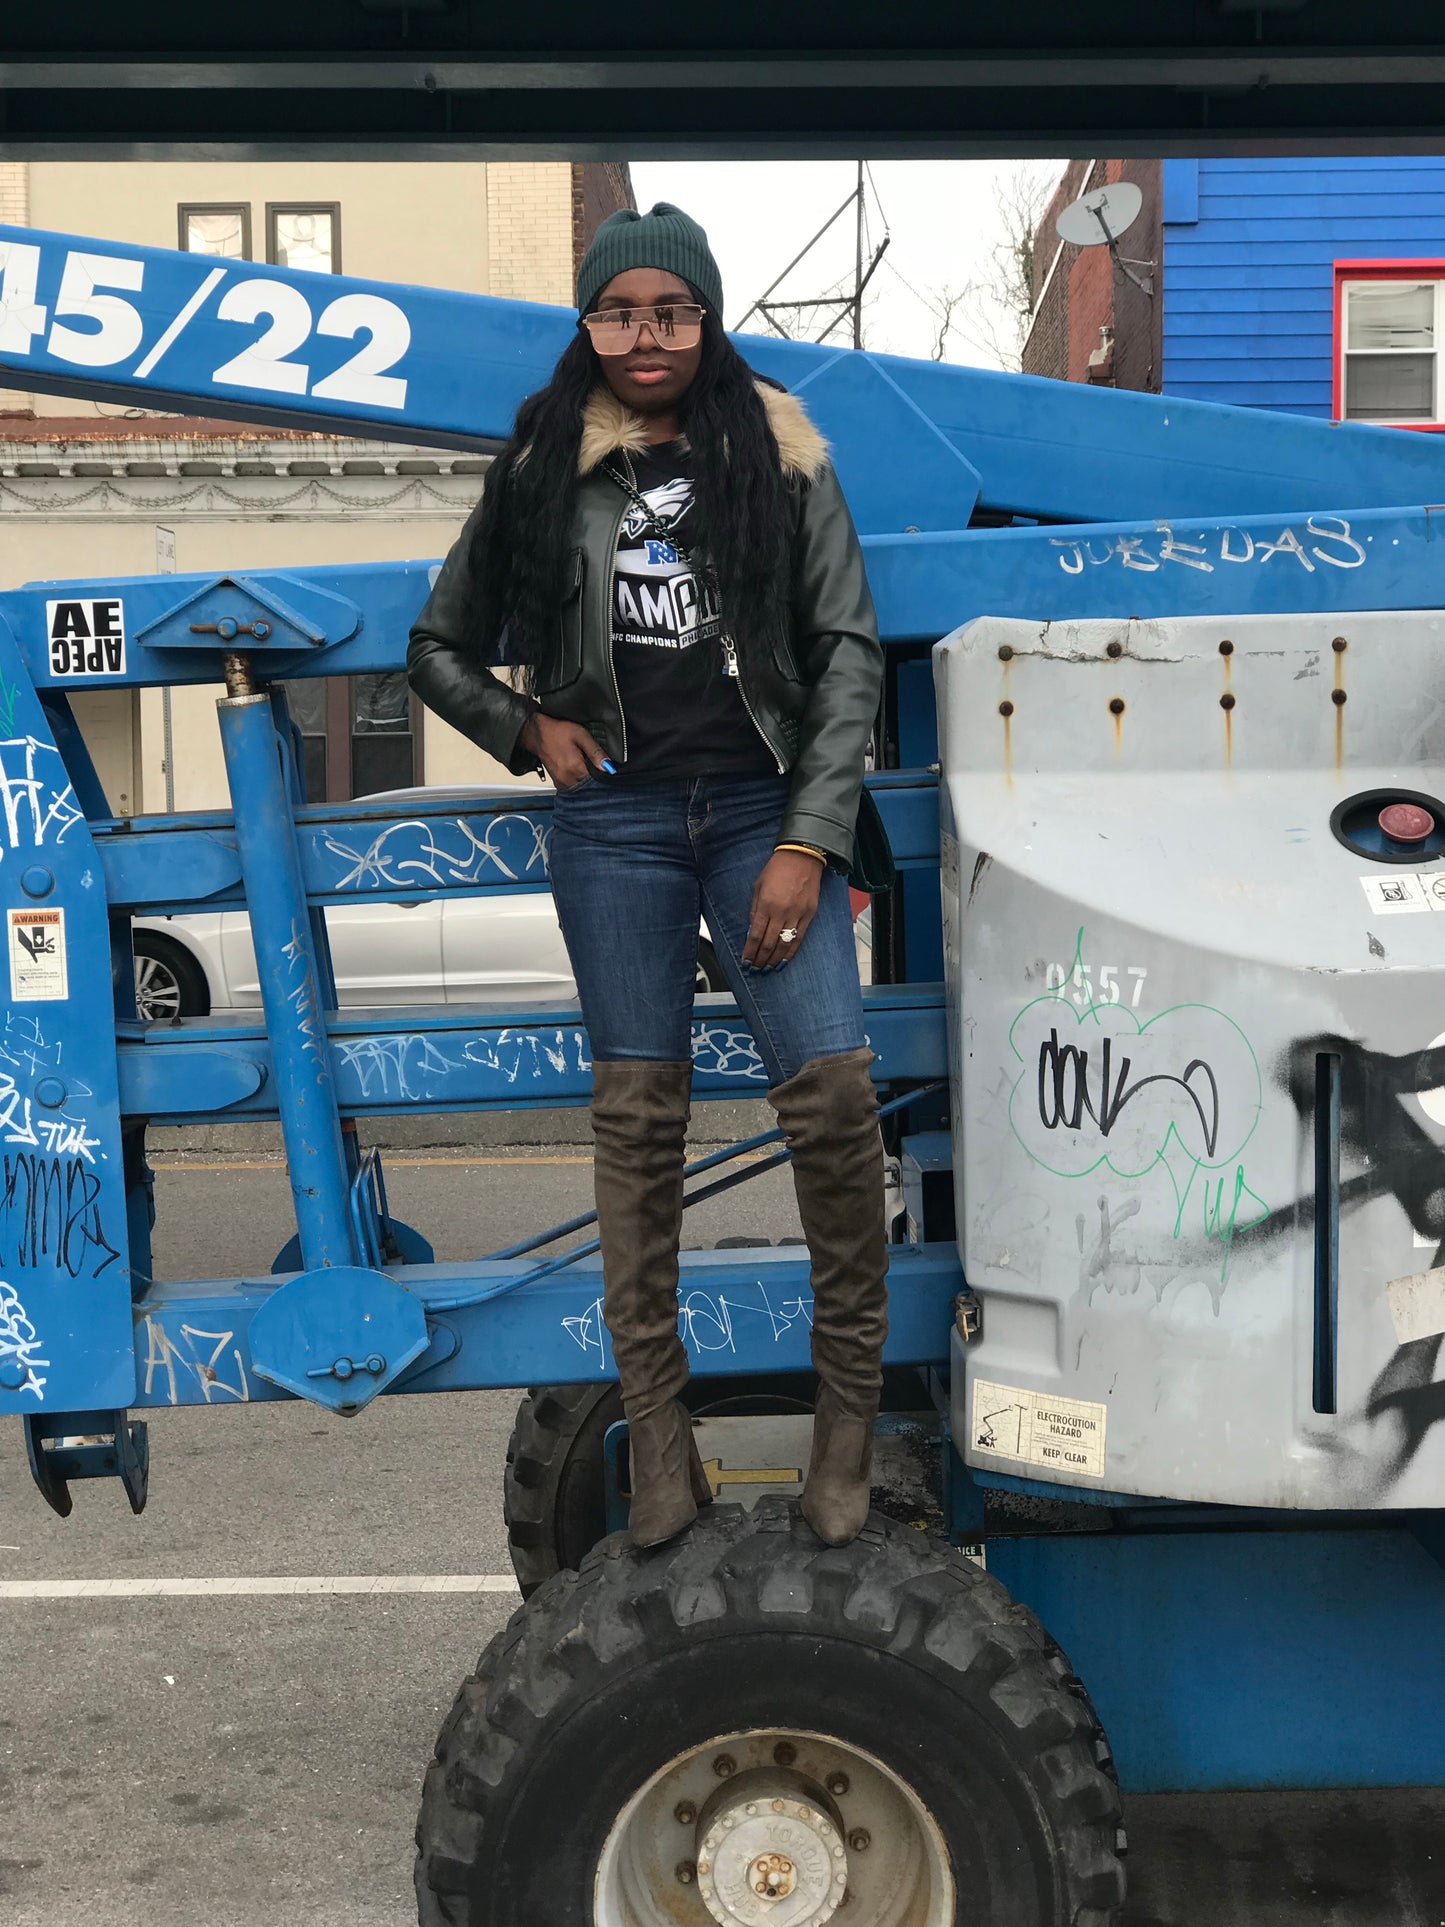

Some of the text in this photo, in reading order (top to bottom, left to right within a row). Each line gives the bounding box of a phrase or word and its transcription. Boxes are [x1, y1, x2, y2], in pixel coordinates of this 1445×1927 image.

[52, 602, 122, 638] AE
[625, 634, 678, 649] CHAMPIONS
[52, 638, 122, 674] APEC
[21, 915, 59, 923] WARNING
[1046, 963, 1147, 1007] 0557
[1037, 1411, 1096, 1430] ELECTROCUTION
[1050, 1424, 1082, 1438] HAZARD
[1042, 1447, 1087, 1464] KEEP CLEAR
